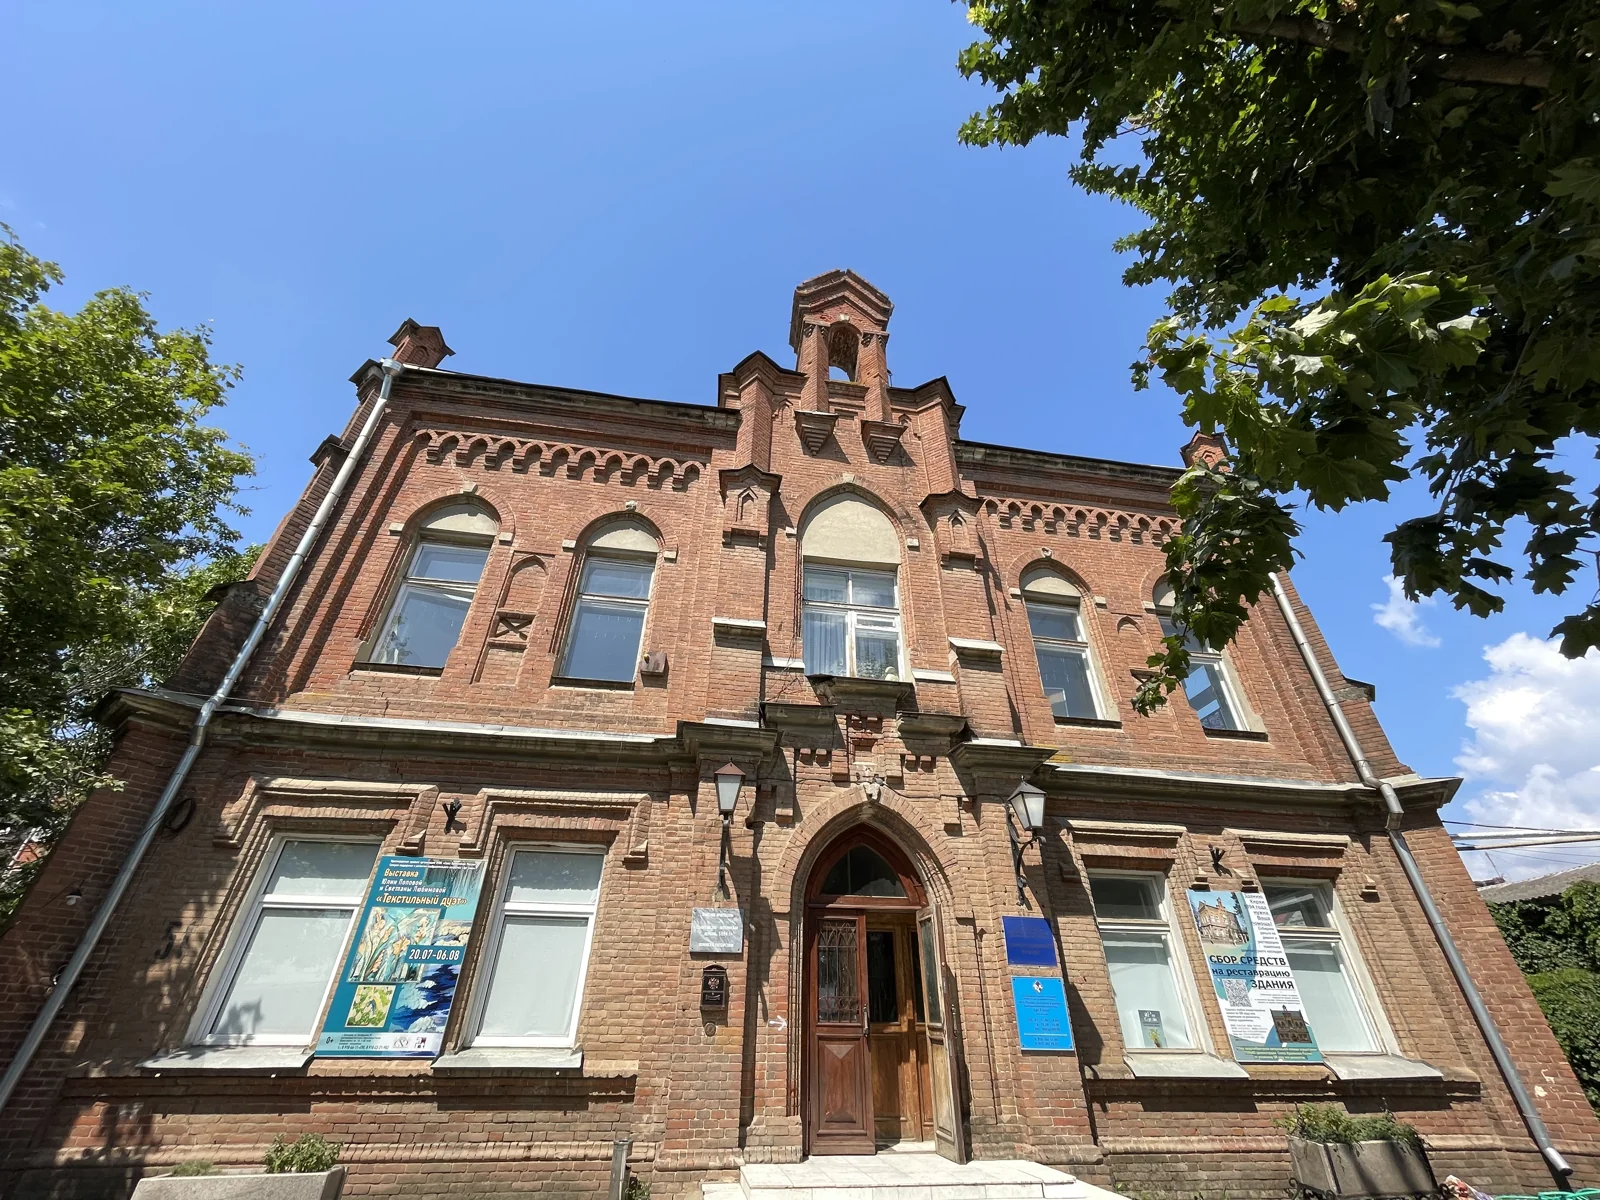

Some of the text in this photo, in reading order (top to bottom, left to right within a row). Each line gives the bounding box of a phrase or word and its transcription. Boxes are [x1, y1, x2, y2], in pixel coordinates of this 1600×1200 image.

[384, 868, 419, 878] Выставка
[376, 893, 467, 907] «Текстильный дуэт»
[408, 948, 460, 961] 20.07-06.08
[1209, 954, 1286, 967] СБОР СРЕДСТВ
[1227, 968, 1291, 977] реставрацию
[1250, 979, 1295, 990] ЗДАНИЯ
